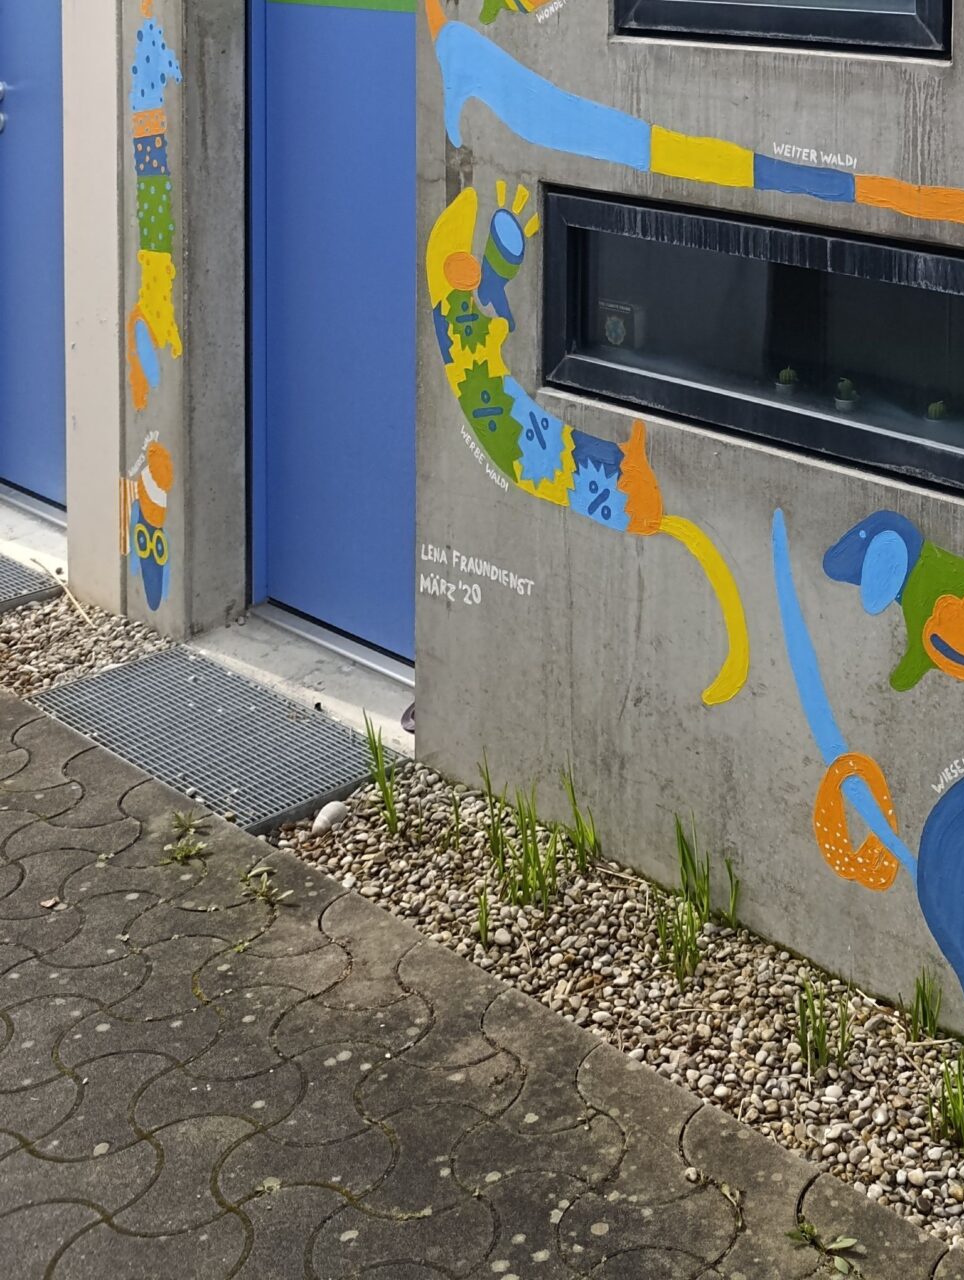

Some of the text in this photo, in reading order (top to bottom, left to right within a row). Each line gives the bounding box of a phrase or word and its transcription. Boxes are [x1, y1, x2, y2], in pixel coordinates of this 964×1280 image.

[773, 141, 858, 170] WEITER WALDI
[459, 424, 510, 493] WERBE WALDI
[419, 572, 482, 606] MÄRZ '20
[421, 543, 535, 597] LENA FRAUNDIENST
